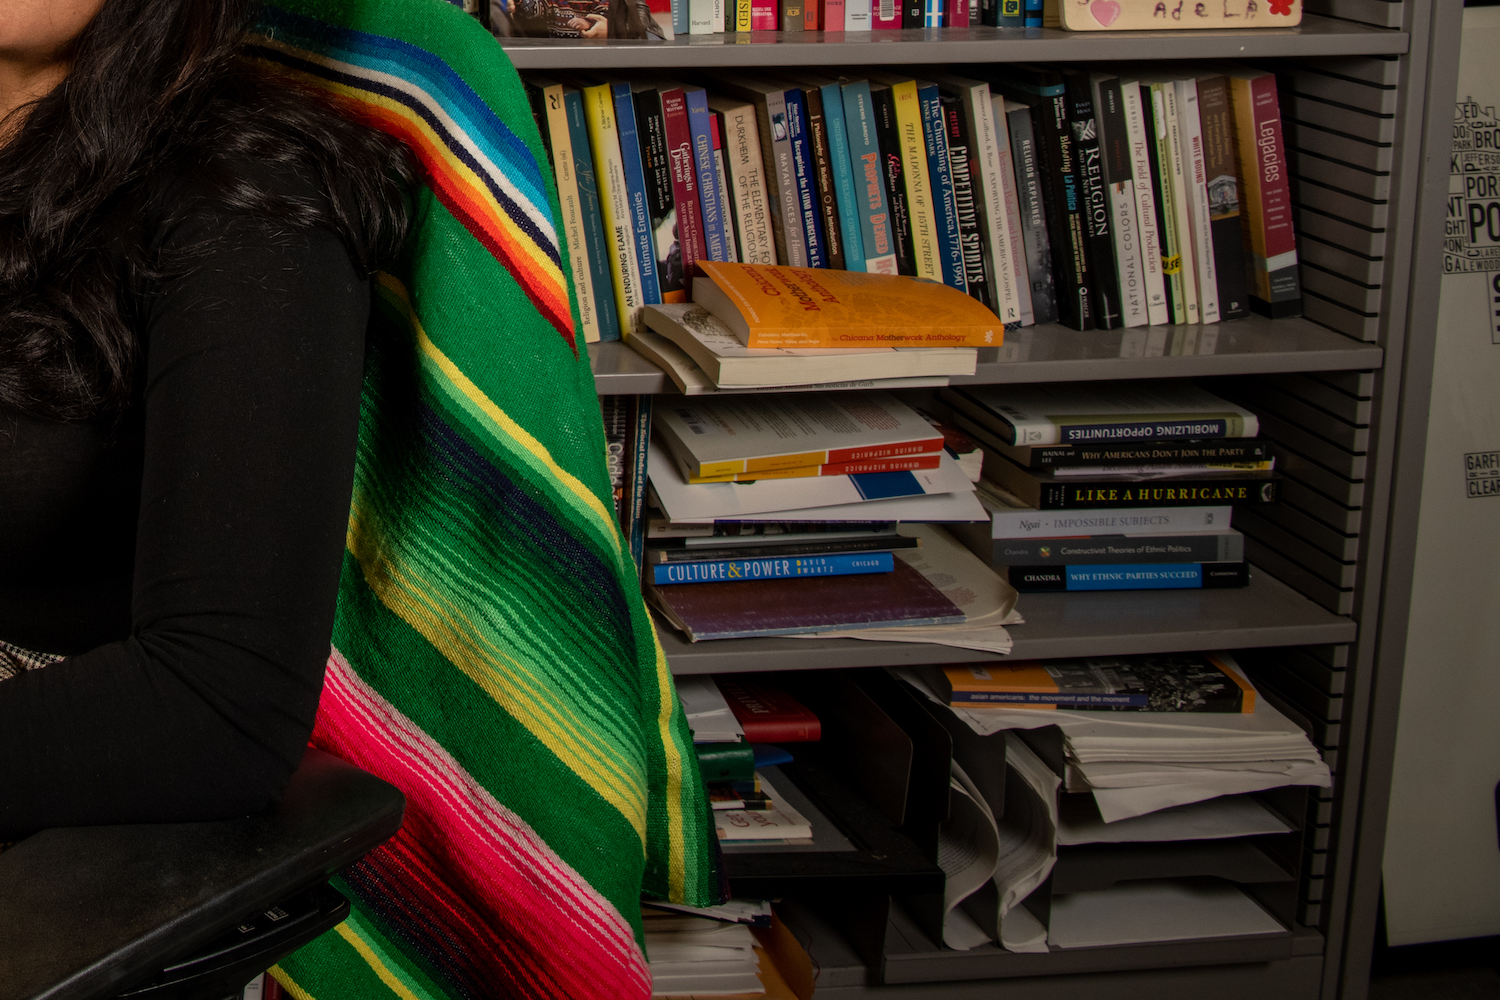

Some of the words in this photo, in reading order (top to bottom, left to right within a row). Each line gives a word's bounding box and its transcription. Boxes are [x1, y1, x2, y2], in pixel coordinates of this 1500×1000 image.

[1258, 118, 1280, 184] Legacies
[860, 152, 882, 210] PROPHETS
[949, 146, 977, 232] COMPETITIVE
[1086, 146, 1109, 238] RELIGION
[633, 191, 648, 234] Enemies
[1120, 202, 1134, 252] COLORS
[869, 213, 890, 255] DENIED
[640, 237, 652, 278] Intimate
[960, 232, 986, 285] SPIRITS
[1125, 254, 1140, 316] NATIONAL
[1068, 426, 1154, 440] OPPORTUNITIES
[1156, 424, 1220, 438] MOBILIZING
[1075, 488, 1118, 502] LIKE
[1122, 488, 1134, 502] A
[1138, 486, 1248, 502] HURRICANE
[1019, 520, 1041, 532] Ngai
[852, 560, 880, 568] CHICAGO
[1024, 574, 1062, 583] CHANDRA
